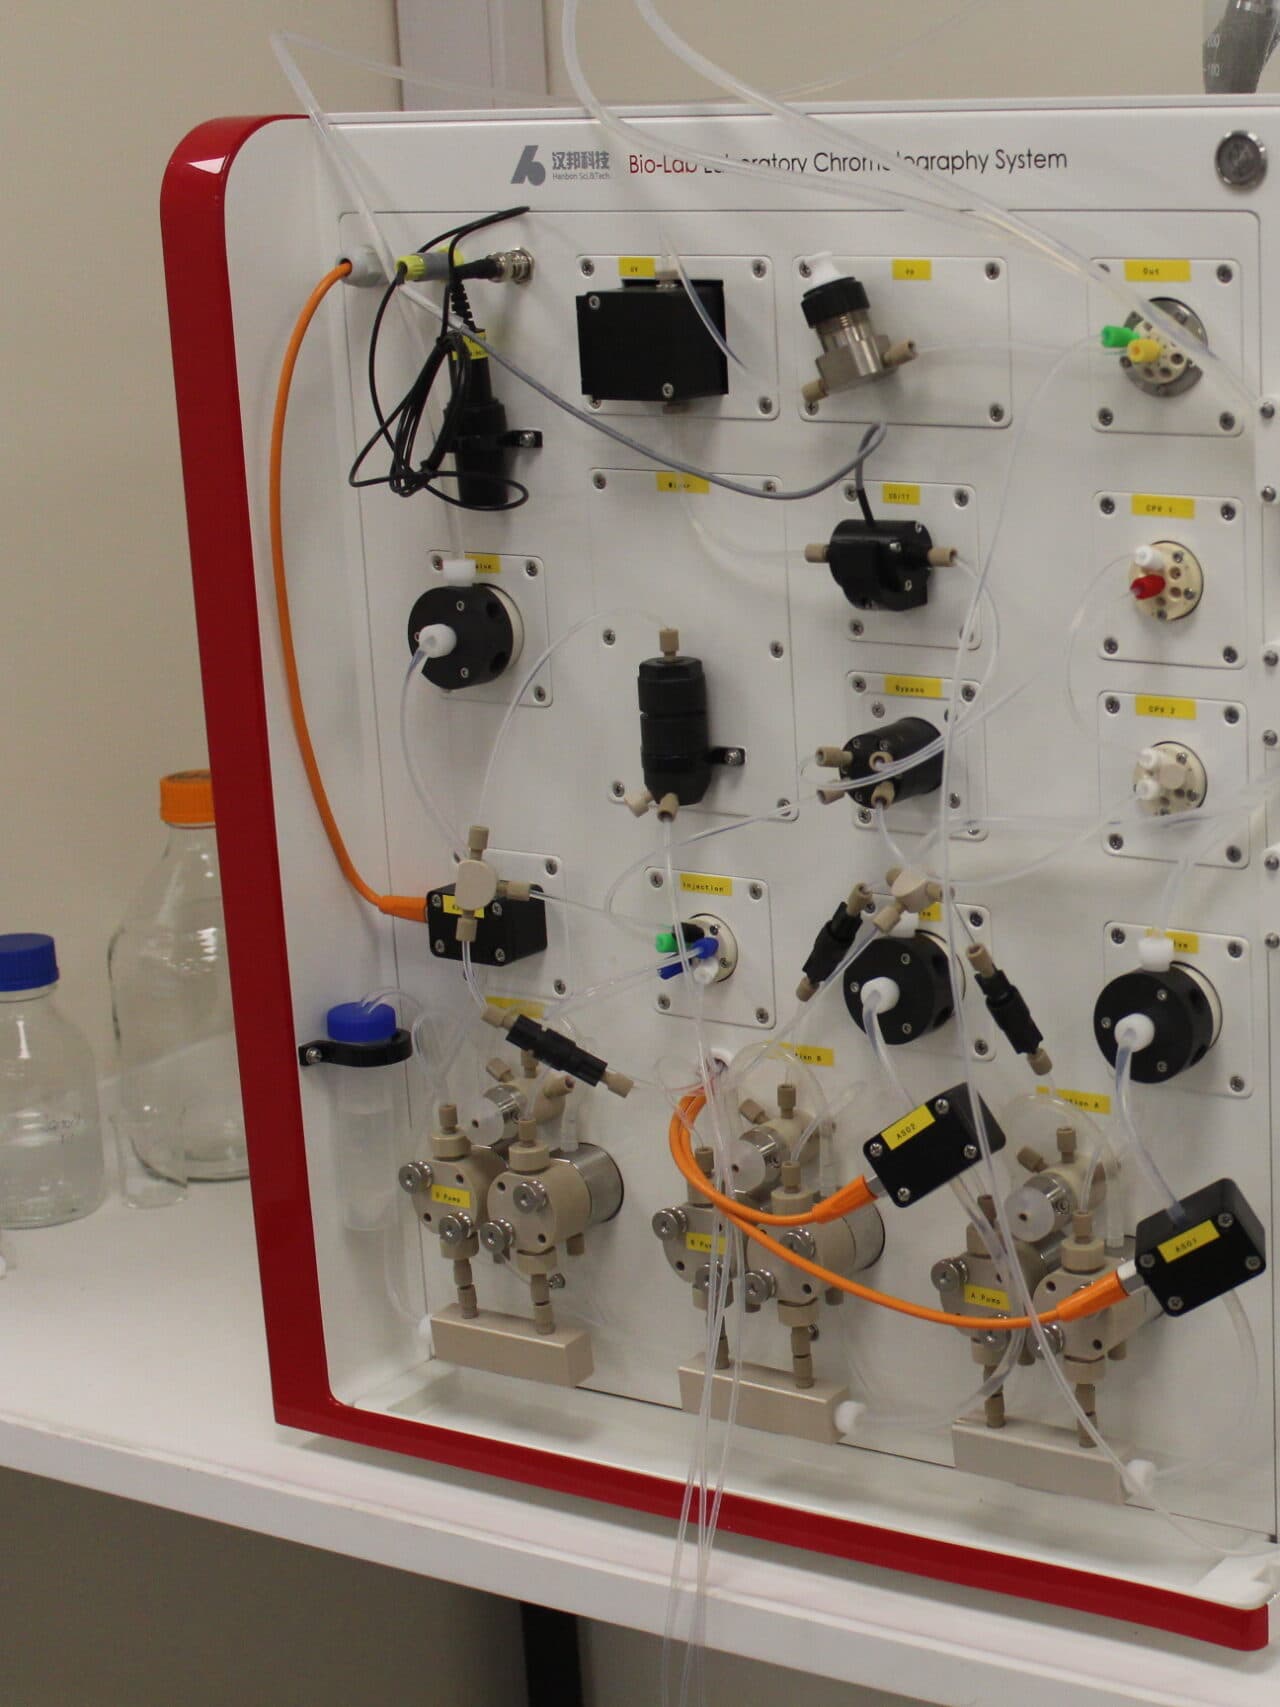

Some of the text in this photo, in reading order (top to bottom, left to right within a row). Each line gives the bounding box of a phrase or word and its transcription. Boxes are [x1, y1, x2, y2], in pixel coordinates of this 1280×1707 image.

[551, 151, 610, 170] 汉邦科技
[995, 148, 1067, 174] System
[682, 881, 724, 893] Injection
[896, 1122, 917, 1141] AS02
